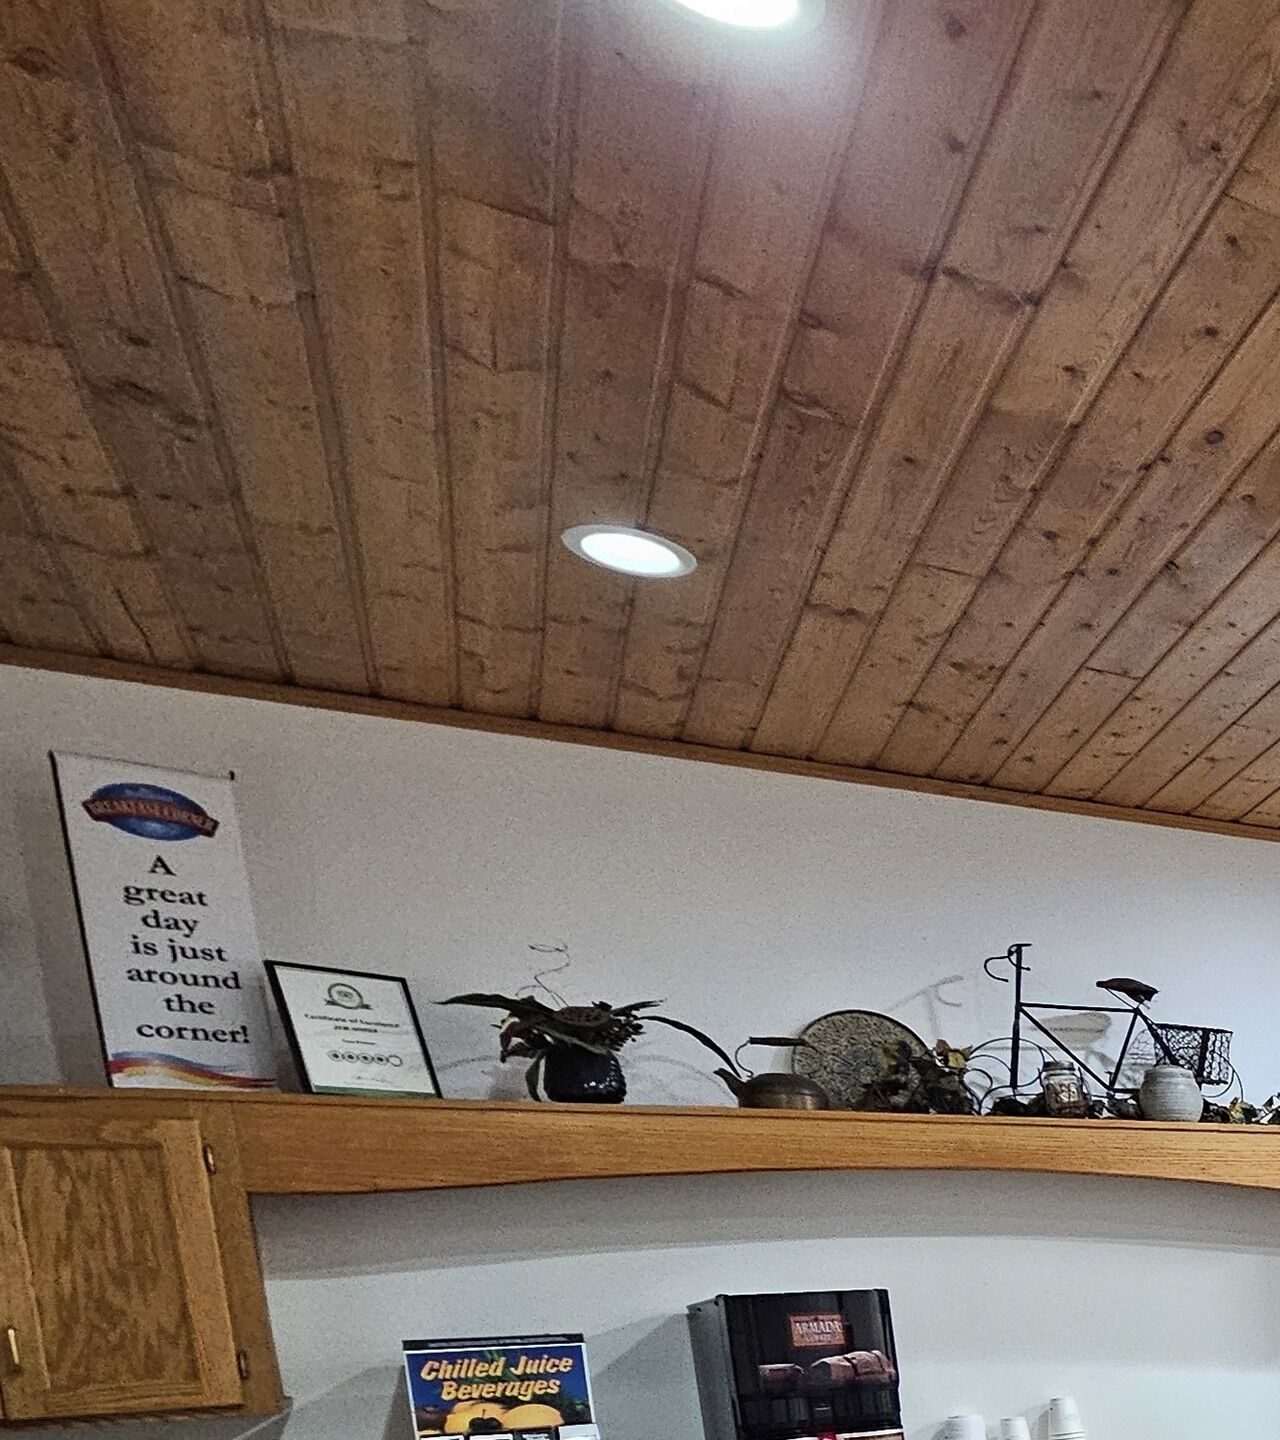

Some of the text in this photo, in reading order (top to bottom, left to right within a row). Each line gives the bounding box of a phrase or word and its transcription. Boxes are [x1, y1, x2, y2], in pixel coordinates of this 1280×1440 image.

[147, 854, 177, 877] A
[123, 885, 208, 906] great
[141, 909, 200, 938] day
[130, 934, 228, 964] is just
[125, 968, 242, 990] around
[163, 993, 216, 1015] the
[135, 1024, 250, 1044] corner!
[420, 1354, 573, 1381] Chilled Juice
[440, 1379, 561, 1401] Beverages
